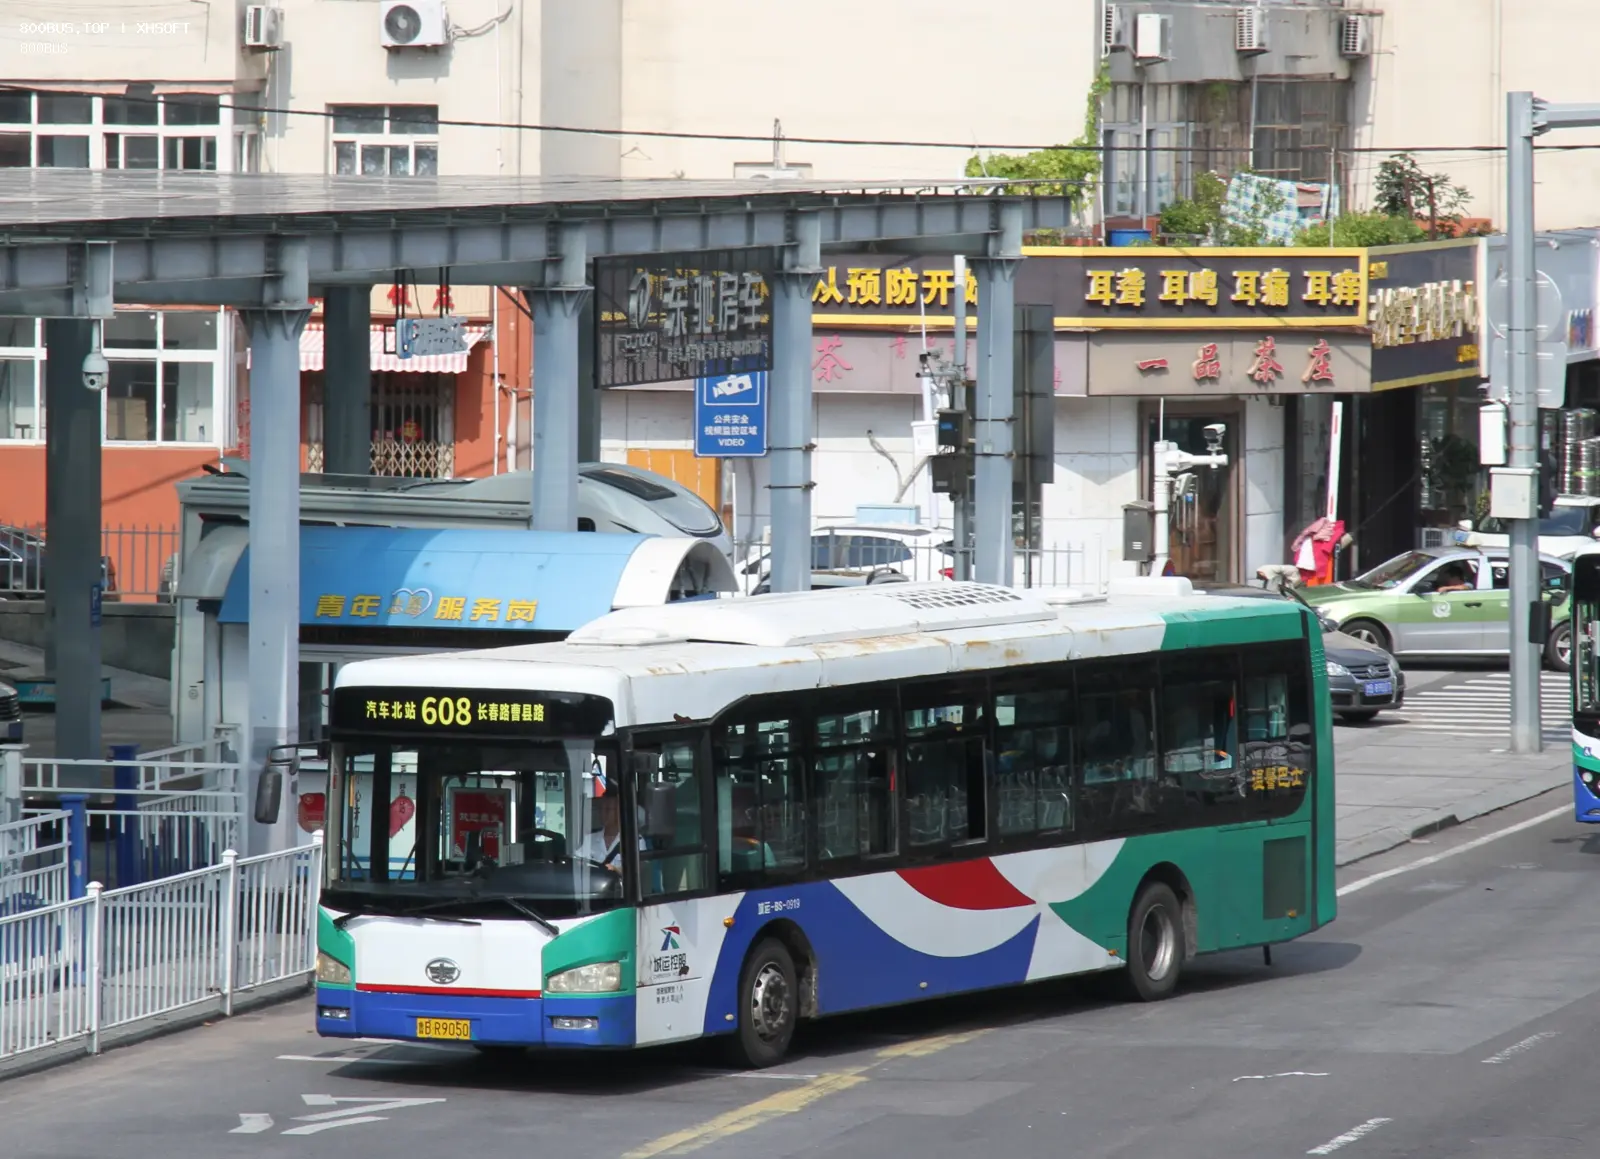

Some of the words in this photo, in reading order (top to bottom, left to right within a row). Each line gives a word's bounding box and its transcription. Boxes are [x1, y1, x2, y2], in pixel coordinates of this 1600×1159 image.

[1086, 268, 1146, 306] 耳聋
[1159, 268, 1218, 306] 耳鸣
[1231, 268, 1291, 306] 耳痛
[1303, 269, 1360, 306] 耳痒
[1136, 336, 1335, 383] 一品茶庄
[713, 414, 749, 424] 公共安全
[718, 438, 745, 447] VIDEO
[366, 700, 416, 720] 汽车北站
[421, 696, 472, 726] 608
[477, 702, 545, 722] 长春路曹县路
